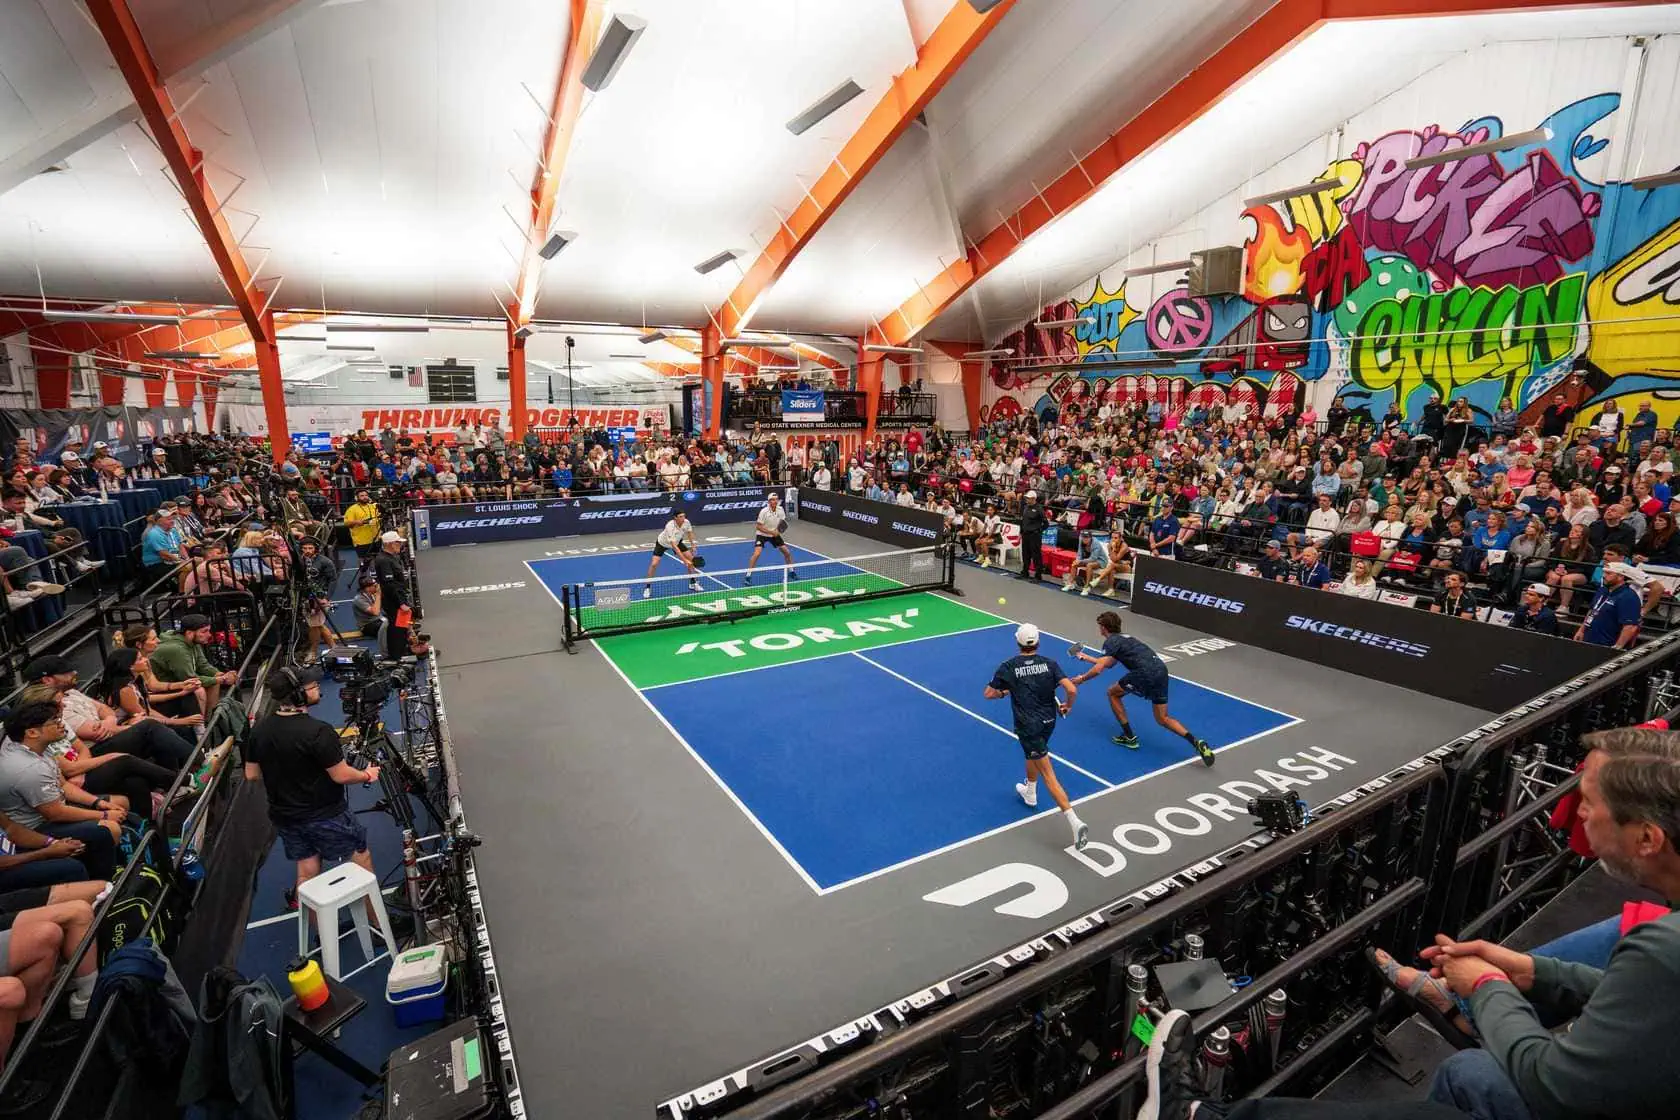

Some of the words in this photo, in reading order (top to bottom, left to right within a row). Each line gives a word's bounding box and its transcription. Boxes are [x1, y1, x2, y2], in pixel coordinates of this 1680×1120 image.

[1075, 299, 1126, 345] OUT
[790, 400, 817, 409] Sliders
[362, 408, 500, 430] THRIVING
[508, 408, 639, 427] OGETHER
[669, 493, 676, 502] 2
[706, 490, 738, 498] COLUMBUS
[739, 489, 762, 497] SLIDERS
[475, 505, 486, 513] ST.
[488, 504, 511, 512] LOUIS
[513, 502, 538, 511] SHOCK
[702, 499, 782, 512] SKECHER
[801, 500, 832, 513] SKECHERS
[578, 506, 673, 520] SKECHERS
[842, 510, 879, 524] SKECHERS
[435, 515, 544, 530] SKECHERS
[892, 521, 937, 539] SKECHERS
[1143, 581, 1245, 614] SKECHERS
[1285, 615, 1432, 657] SKECHERS
[1064, 745, 1357, 878] DOORDASH
